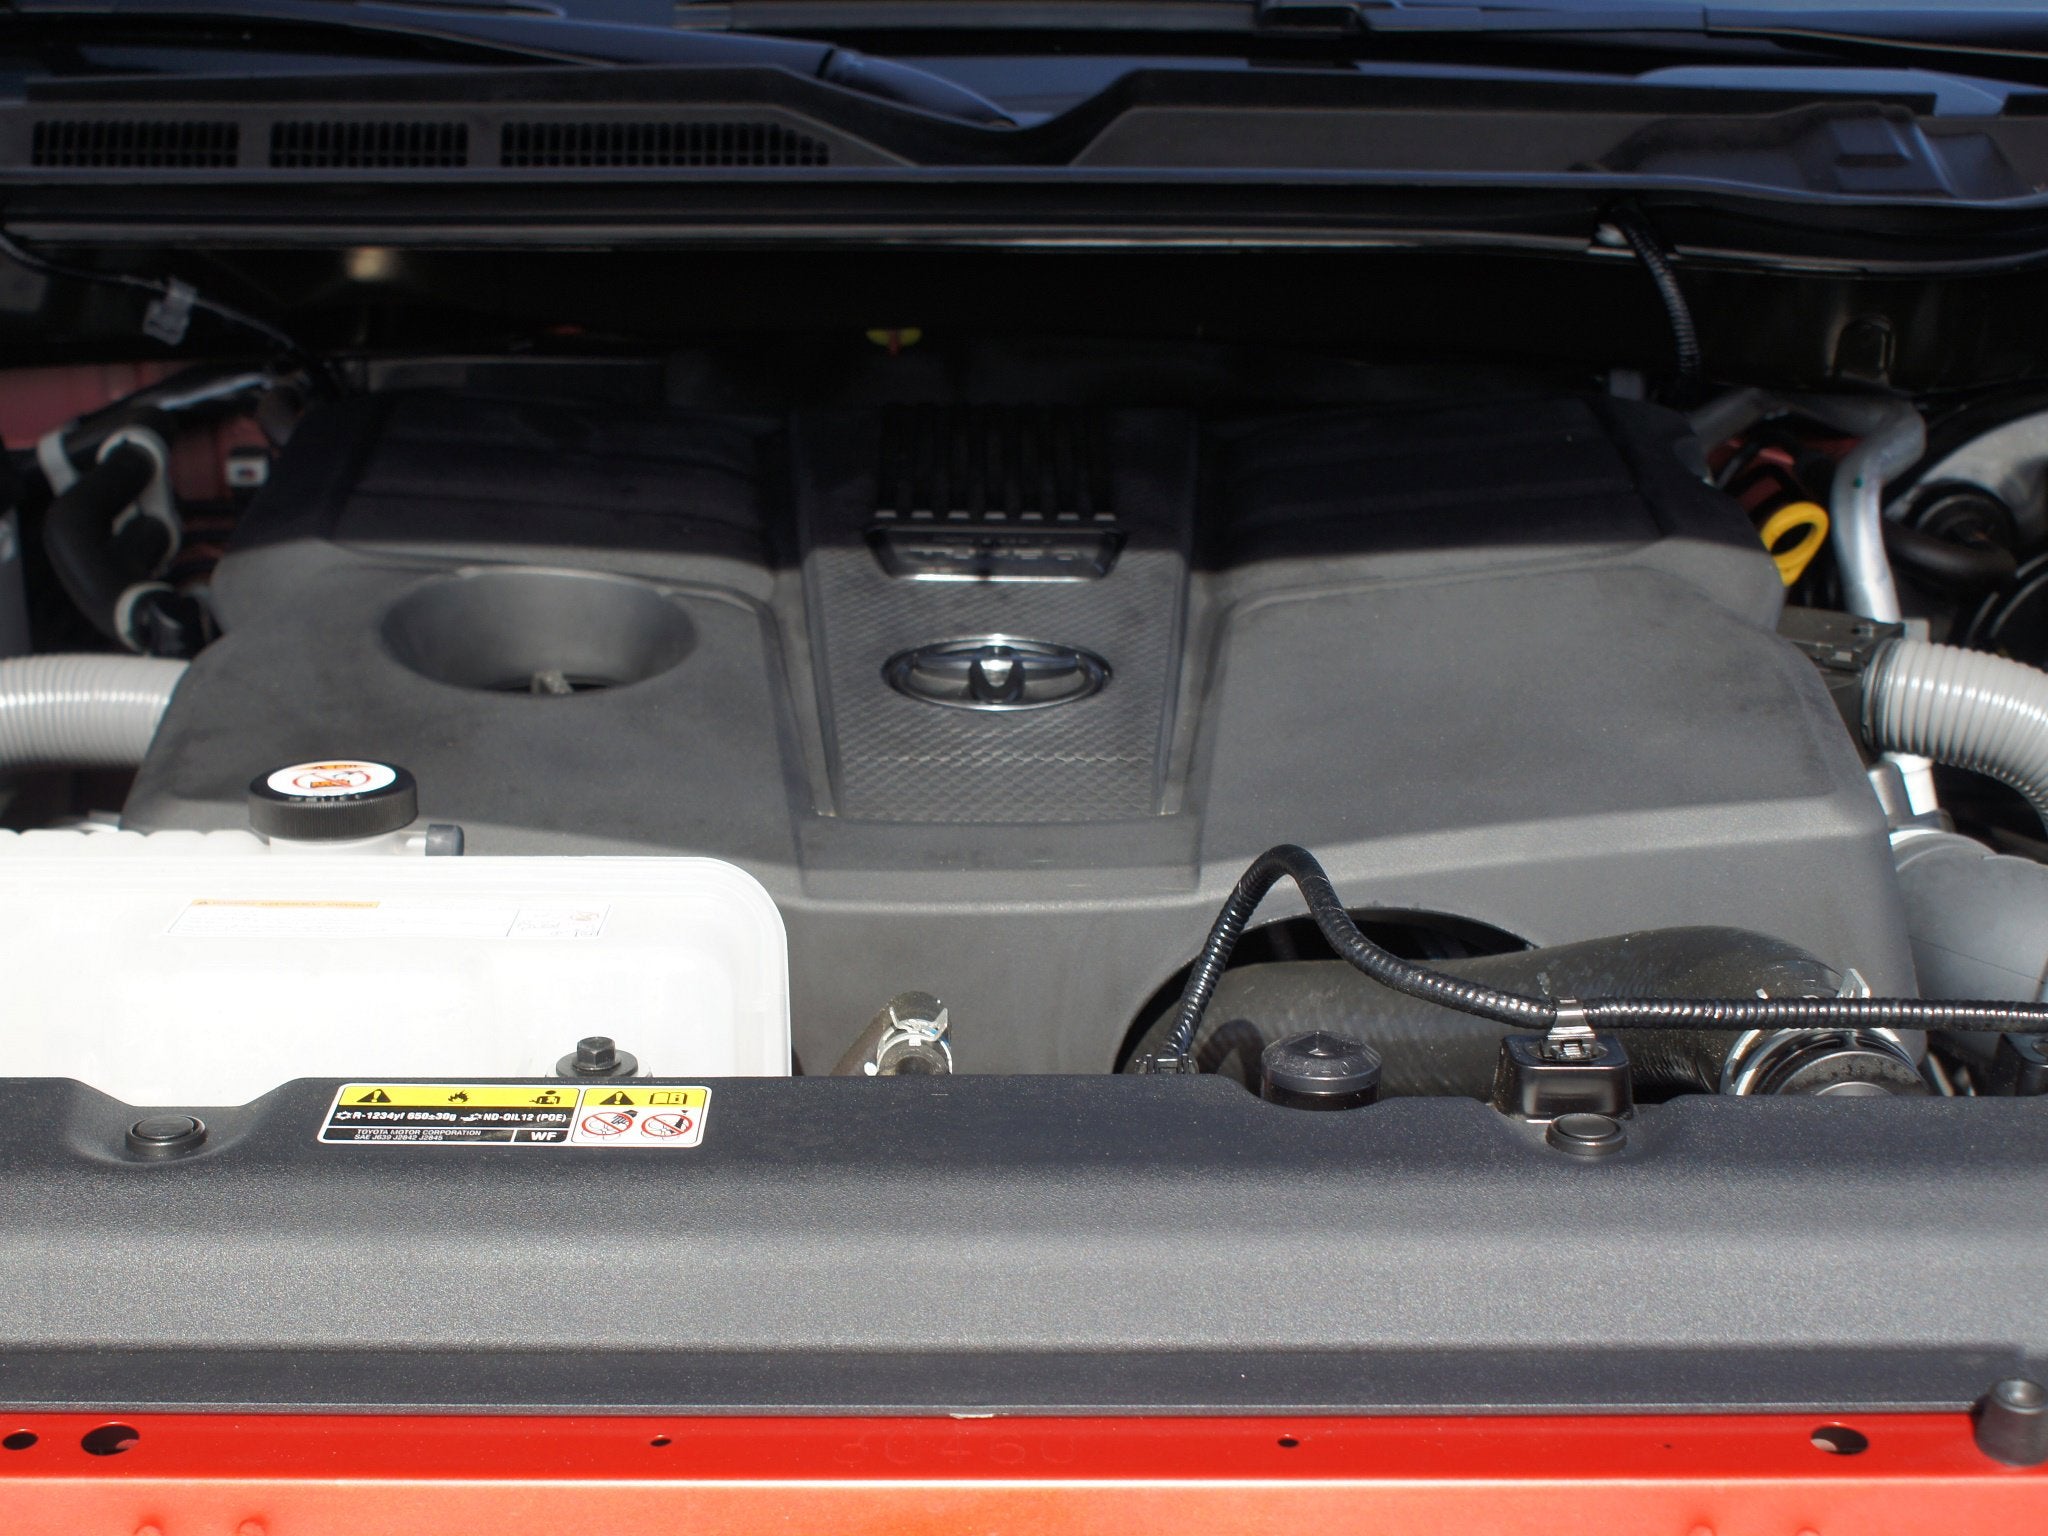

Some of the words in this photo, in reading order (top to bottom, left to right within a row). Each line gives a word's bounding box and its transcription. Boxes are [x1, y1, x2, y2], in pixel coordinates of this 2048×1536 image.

[352, 1112, 404, 1120] R-1234yf
[407, 1112, 457, 1121] 650±30g
[422, 1129, 481, 1137] CORPORATION
[531, 1131, 558, 1141] WF
